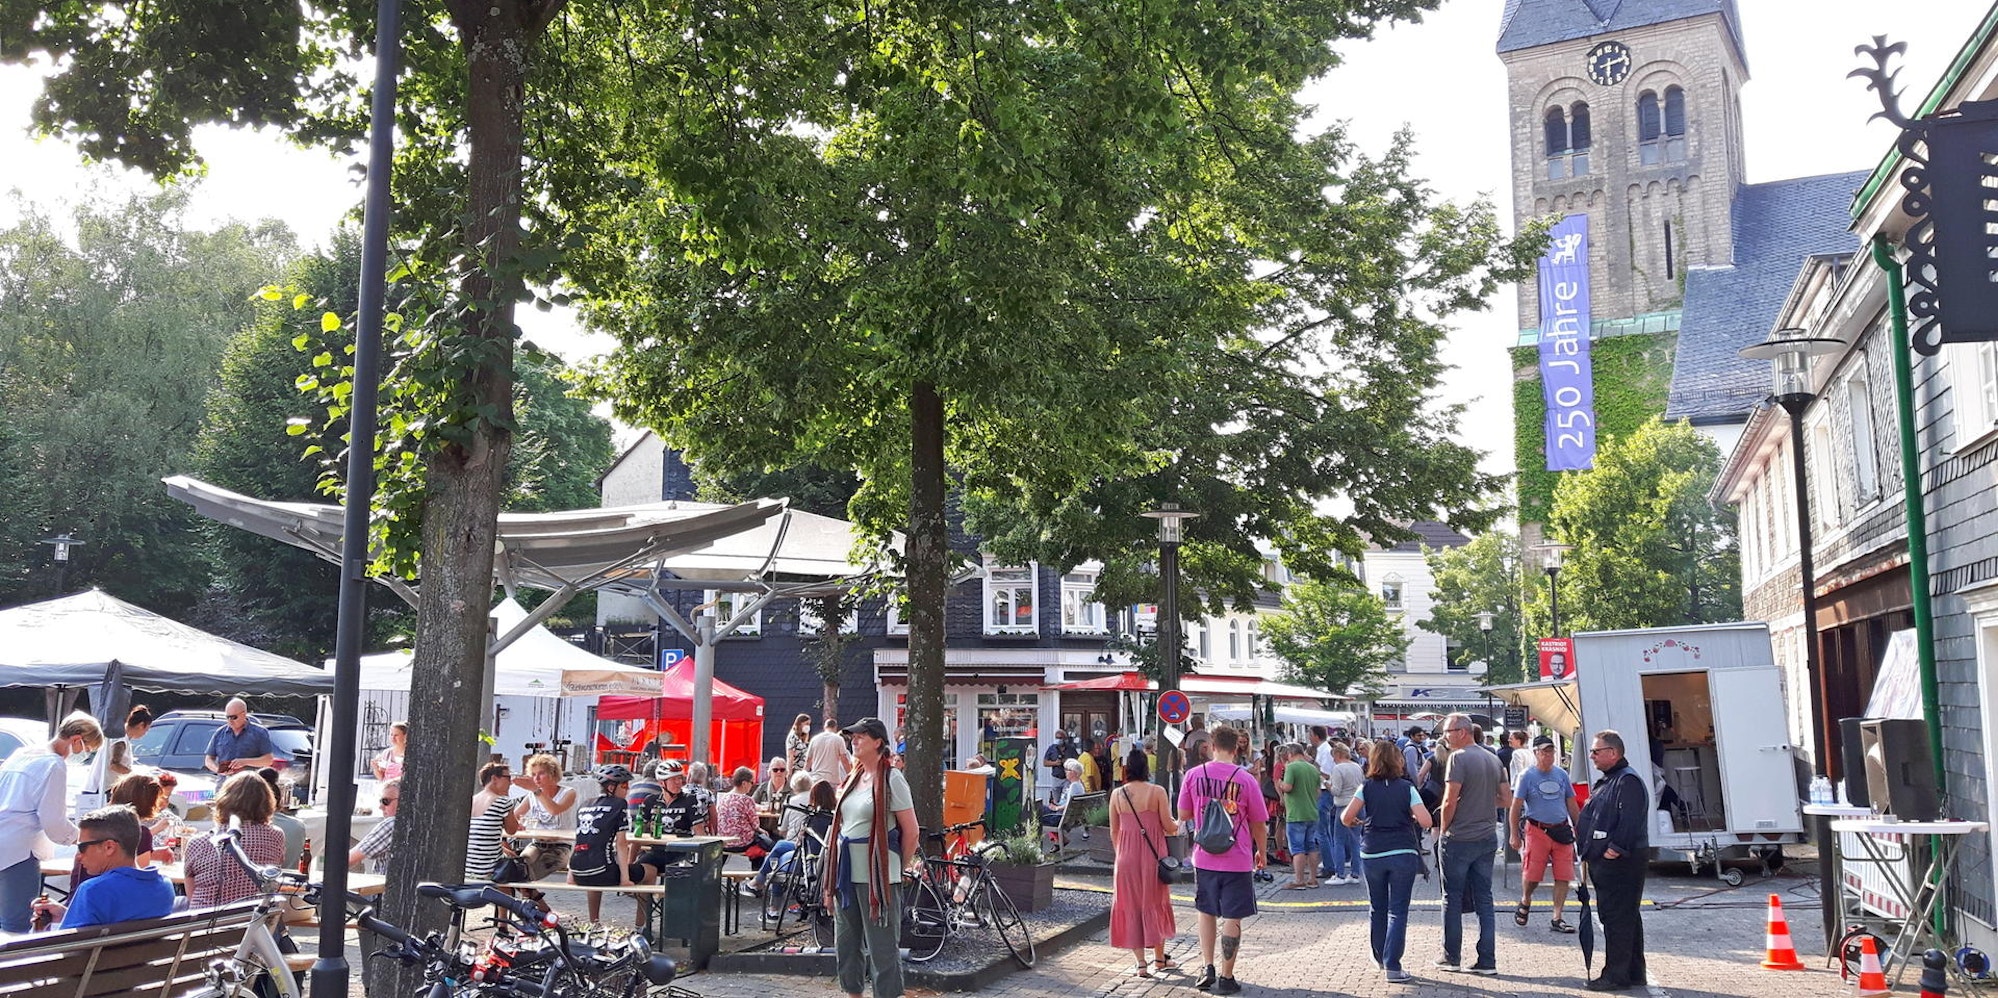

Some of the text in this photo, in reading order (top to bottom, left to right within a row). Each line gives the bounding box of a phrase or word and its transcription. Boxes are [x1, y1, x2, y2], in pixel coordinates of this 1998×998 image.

[1546, 281, 1591, 449] 250 Jahre
[665, 652, 677, 669] P
